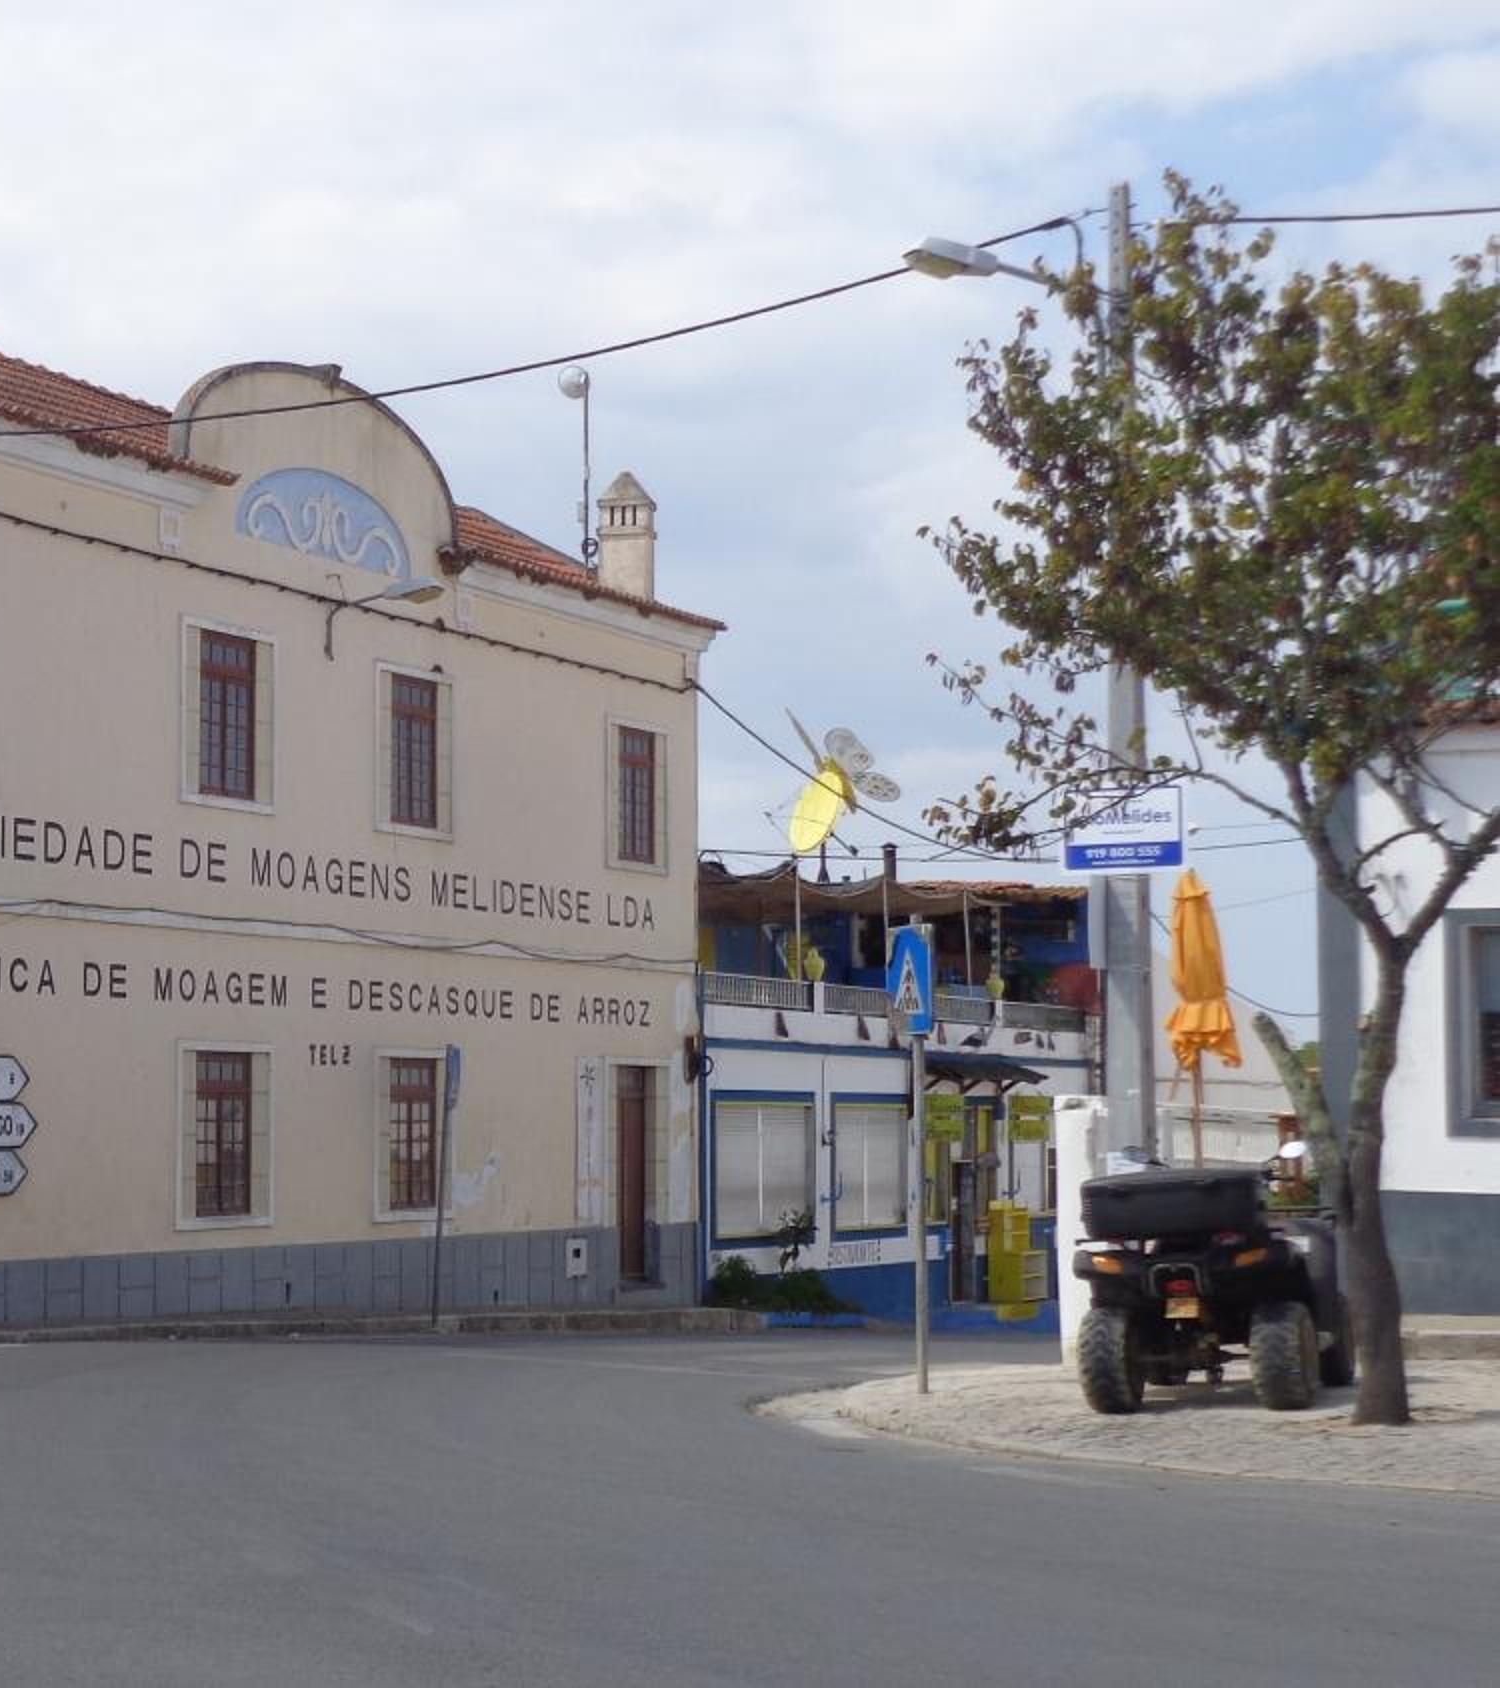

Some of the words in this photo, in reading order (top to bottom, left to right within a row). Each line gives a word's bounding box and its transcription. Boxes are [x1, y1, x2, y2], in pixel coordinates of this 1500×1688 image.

[179, 838, 227, 883] DE
[250, 847, 412, 902] MOAGENS
[430, 871, 592, 925] MELIDENSE
[607, 895, 656, 931] LDA
[83, 961, 127, 999] DE
[154, 967, 288, 1007] MOAGEM
[311, 977, 327, 1009] E
[348, 979, 514, 1020] DESCASQUE
[531, 993, 560, 1023] DE
[577, 997, 652, 1028] ARROZ
